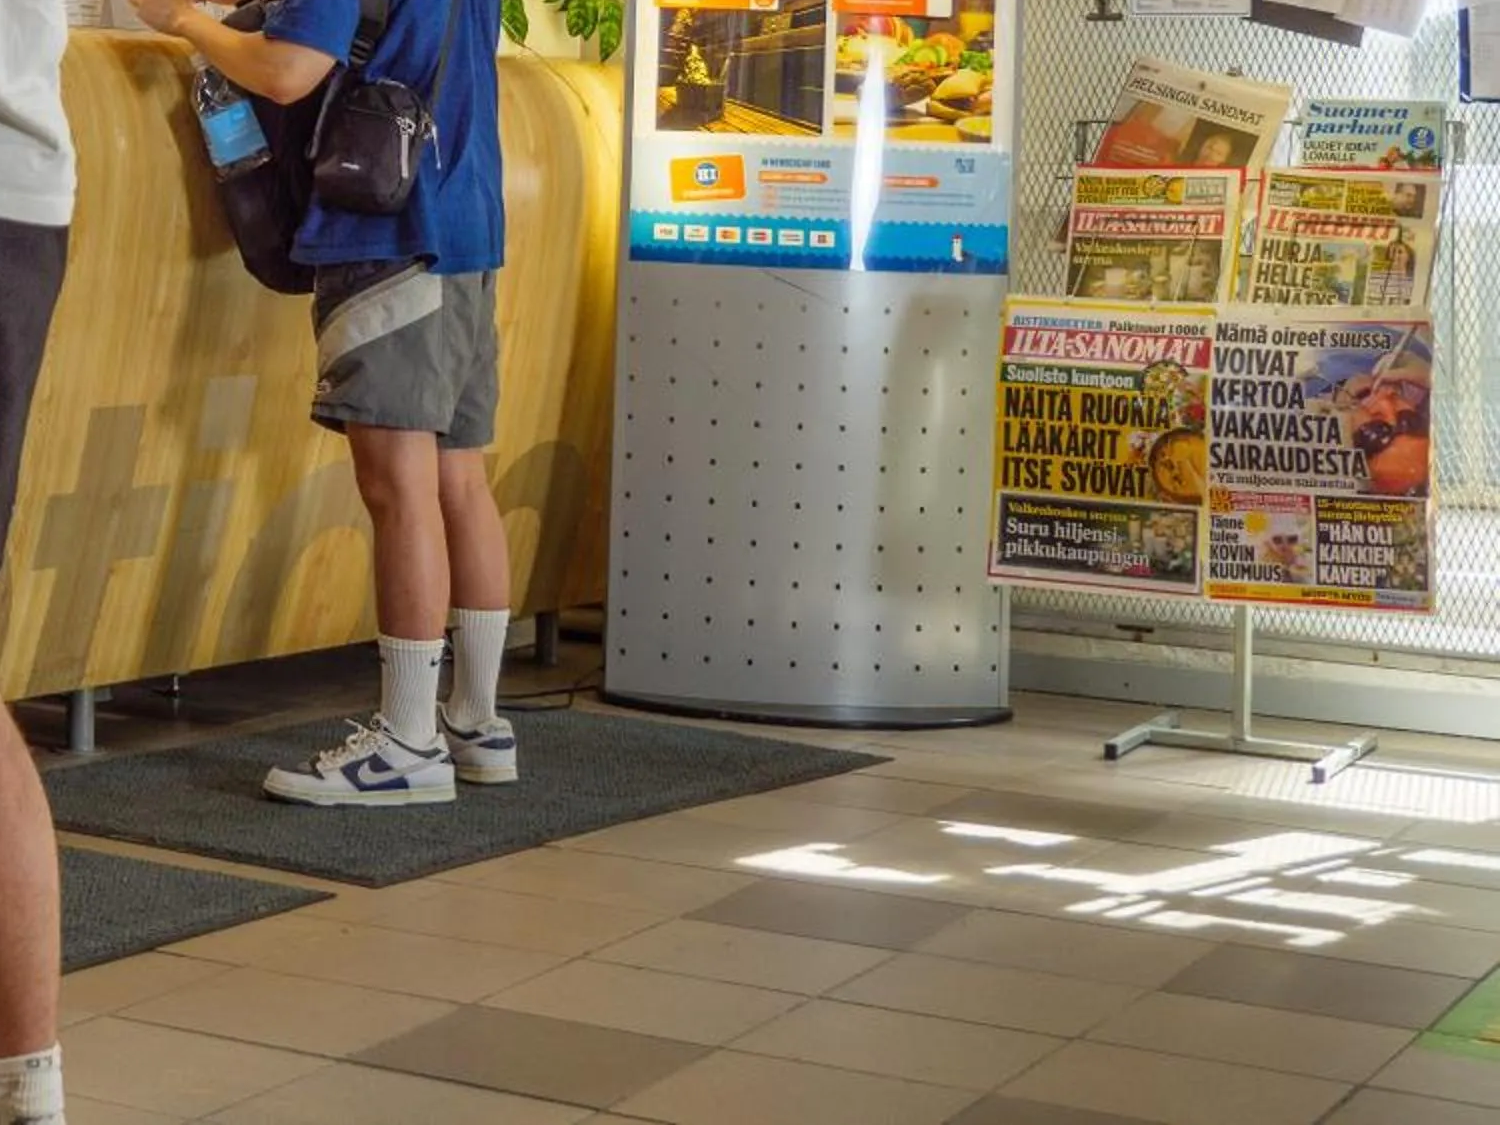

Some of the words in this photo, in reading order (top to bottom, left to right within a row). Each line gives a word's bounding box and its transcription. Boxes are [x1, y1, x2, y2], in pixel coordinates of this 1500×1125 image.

[1129, 77, 1198, 107] HELSINGIN
[1199, 98, 1265, 126] SANOMAT
[1309, 103, 1408, 119] Suomen
[1306, 119, 1404, 138] parhaat
[1259, 238, 1322, 263] HURJA
[1256, 263, 1320, 289] HELLE-
[1010, 330, 1204, 366] ILTA-SANOMAT
[1215, 323, 1268, 345] Nämä
[1272, 326, 1326, 348] oireet
[1329, 332, 1391, 350] suussa
[1214, 347, 1299, 377] VOIVAT
[1007, 364, 1068, 383] Suolisto
[1071, 369, 1134, 388] kuntoon
[1211, 378, 1305, 410] KERTOA
[1005, 386, 1073, 422] NÄITÄ
[1080, 392, 1171, 429] RUOKIA
[1003, 421, 1121, 460] LÄÄKÄRIT
[1211, 410, 1342, 445] VAKAVASTA
[1210, 443, 1369, 478] SAIRAUDESTA
[1002, 456, 1053, 491] ITSE
[1061, 460, 1148, 498] SYÖVÄT
[1006, 518, 1050, 536] Suru
[1054, 521, 1118, 544] hiljensi
[1210, 530, 1239, 543] tulee
[1366, 525, 1393, 545] OLI
[1005, 538, 1151, 568] pikkukaupungin
[1209, 544, 1255, 562] KOVIN
[1319, 543, 1395, 566] KAIKKIEN
[1209, 562, 1282, 582] KUUMUUS
